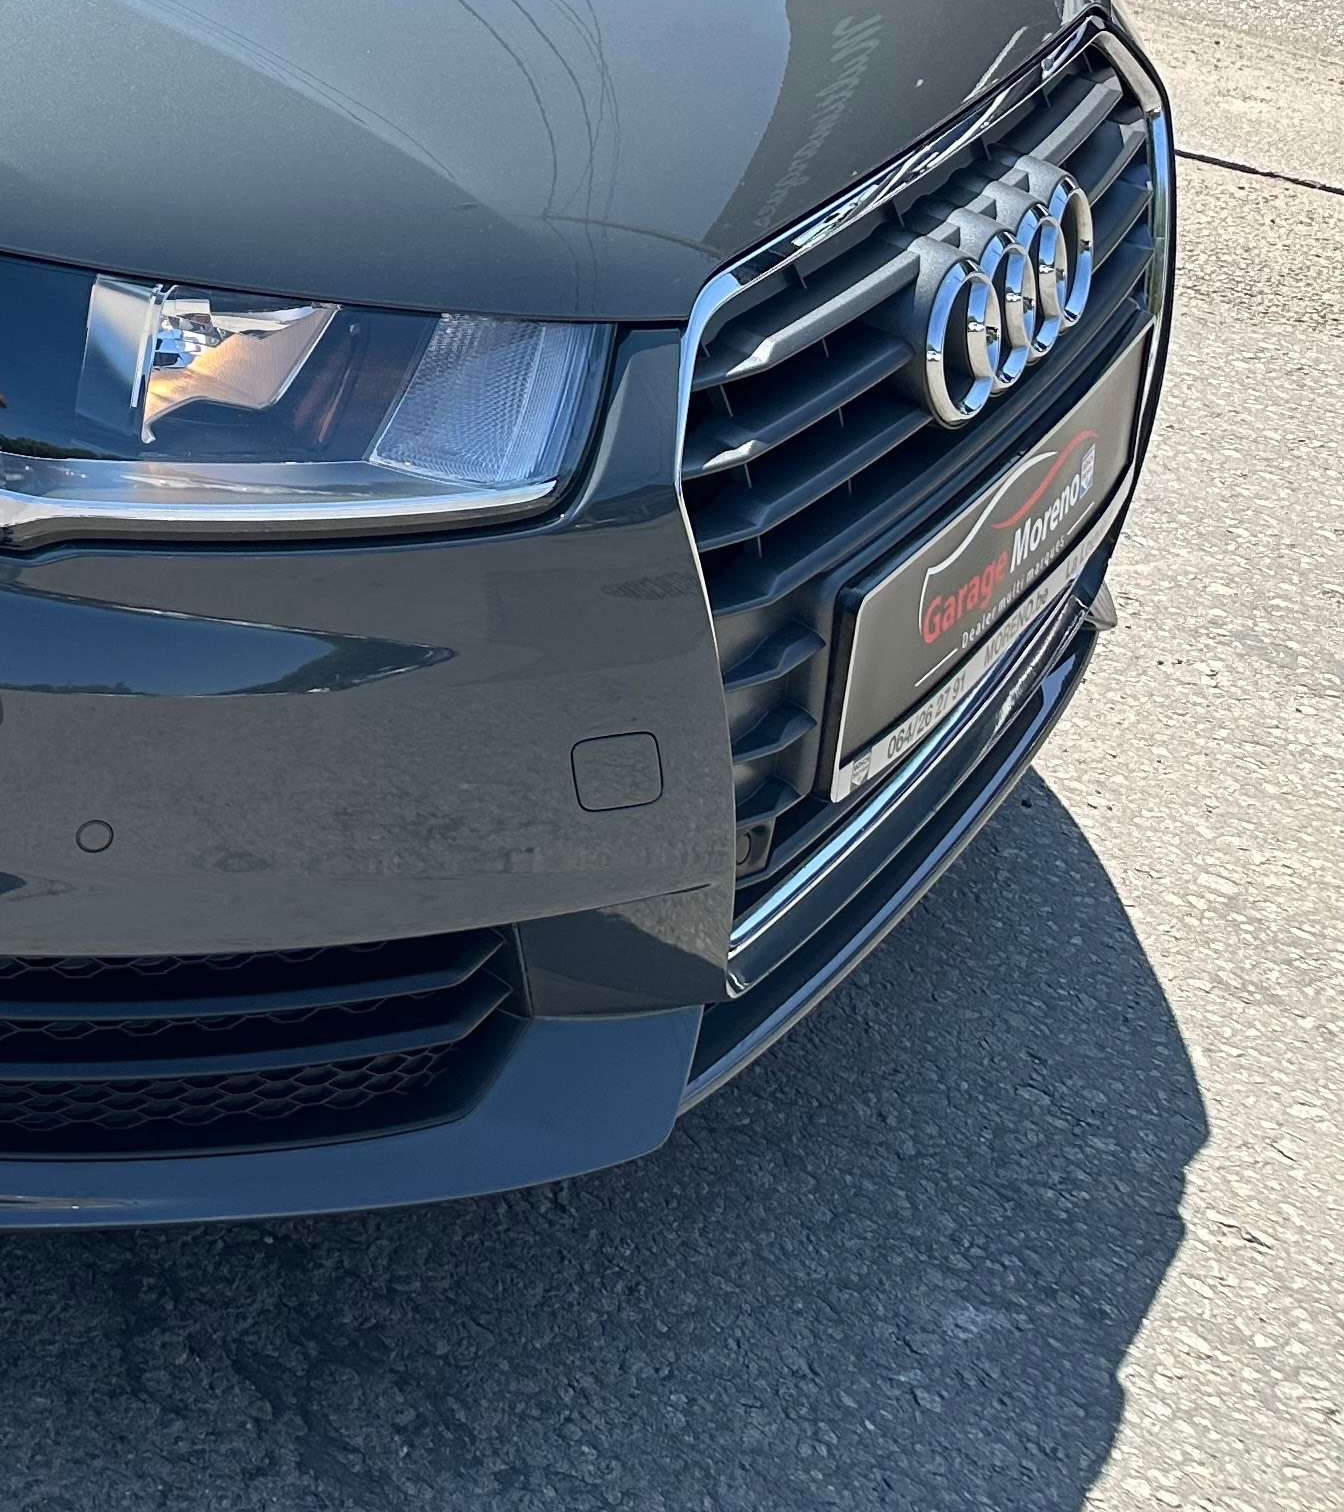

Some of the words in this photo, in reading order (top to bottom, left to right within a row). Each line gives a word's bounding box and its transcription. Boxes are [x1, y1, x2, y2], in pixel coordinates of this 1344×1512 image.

[922, 550, 1008, 644] Garage
[1009, 473, 1081, 574] Moreno
[961, 610, 999, 649] Dealer
[998, 577, 1026, 611] multi
[1025, 536, 1066, 583] marques
[886, 702, 934, 760] 064/26
[936, 687, 952, 720] 27
[952, 671, 967, 705] 91
